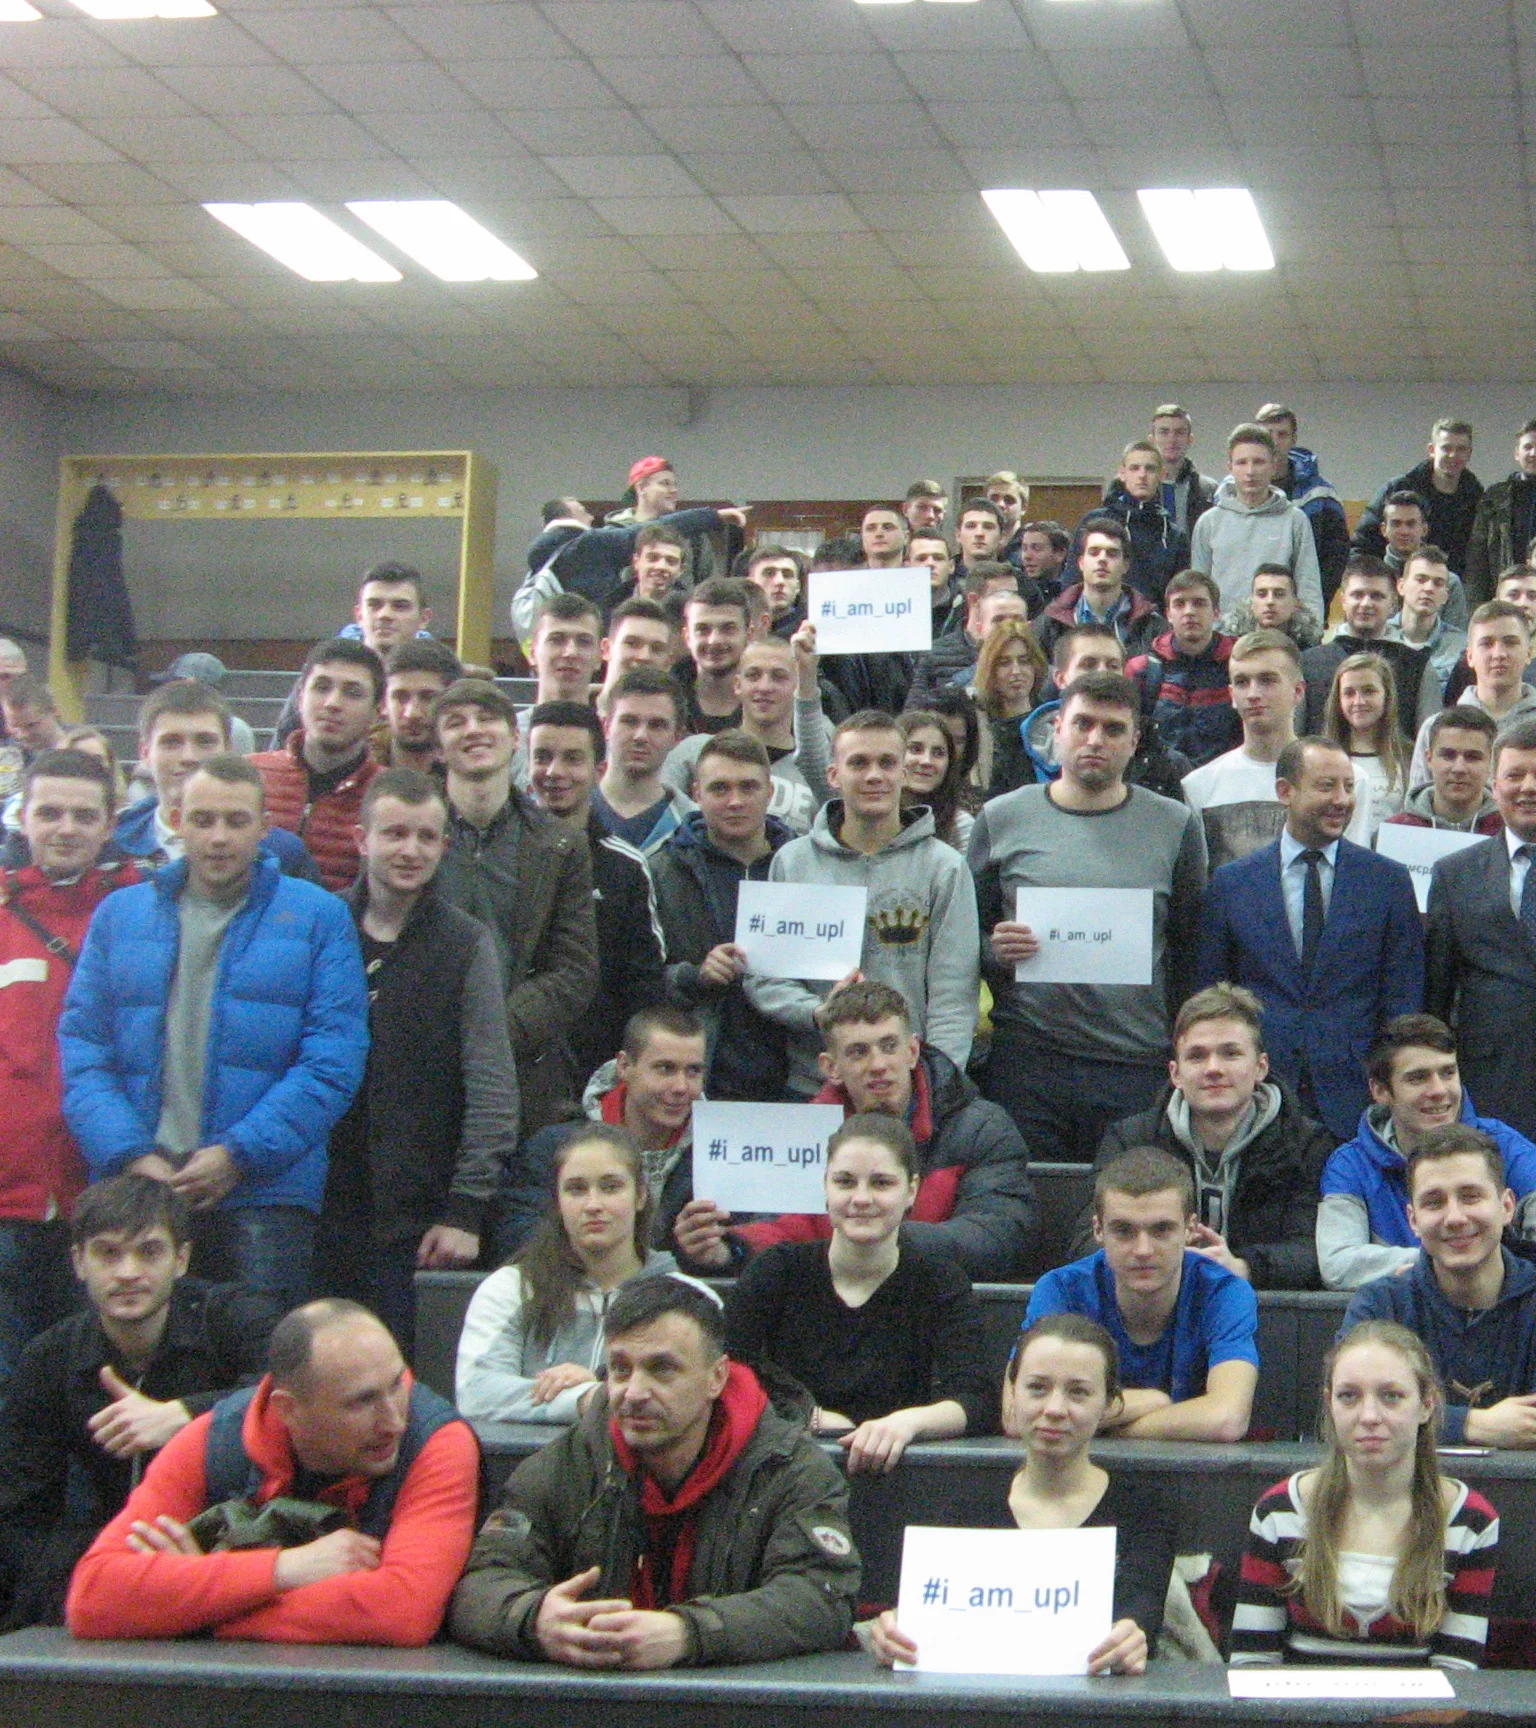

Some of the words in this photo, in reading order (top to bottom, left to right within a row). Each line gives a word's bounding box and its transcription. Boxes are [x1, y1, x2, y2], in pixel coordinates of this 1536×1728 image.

[820, 598, 912, 619] #i_am_upl
[749, 914, 845, 942] #i_am_upl
[1049, 929, 1112, 944] #i_am_upl
[708, 1140, 821, 1169] #i_am_upl
[922, 1577, 1080, 1615] #i_am_upl
